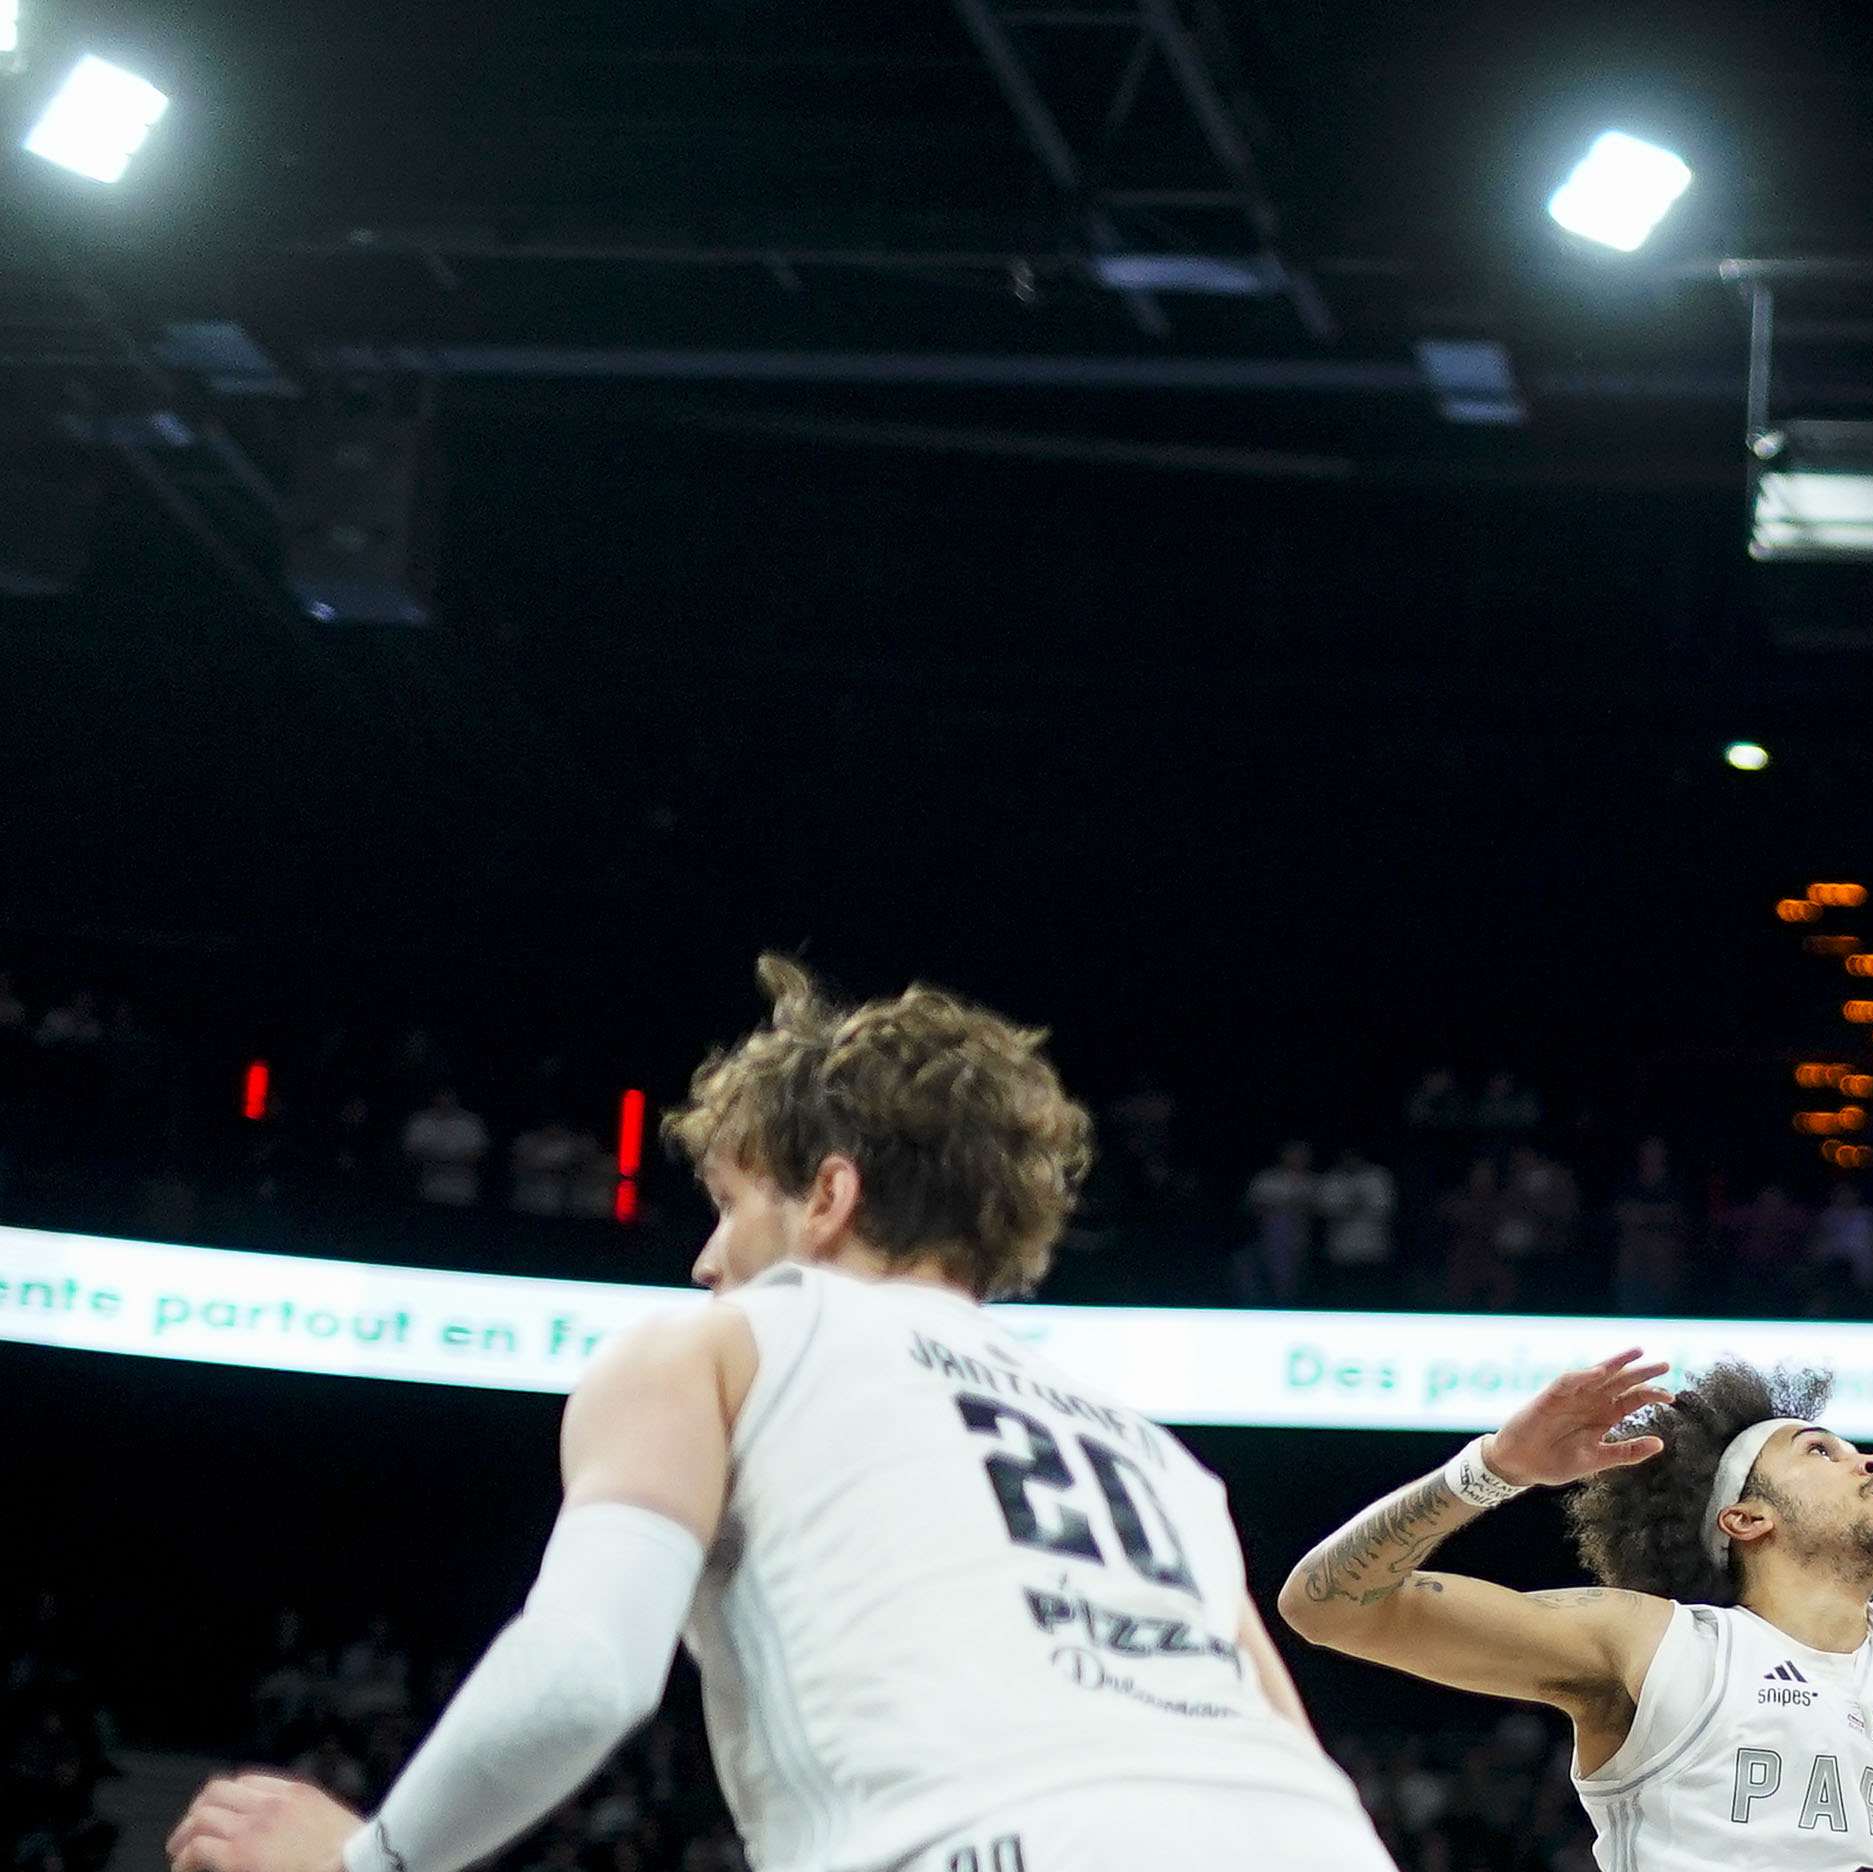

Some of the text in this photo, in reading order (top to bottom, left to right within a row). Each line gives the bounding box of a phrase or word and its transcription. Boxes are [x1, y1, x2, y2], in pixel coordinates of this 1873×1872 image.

[153, 1294, 414, 1344] partout
[438, 1322, 518, 1355] en
[953, 1391, 1207, 1604] 20
[1757, 1687, 1812, 1707] snipes
